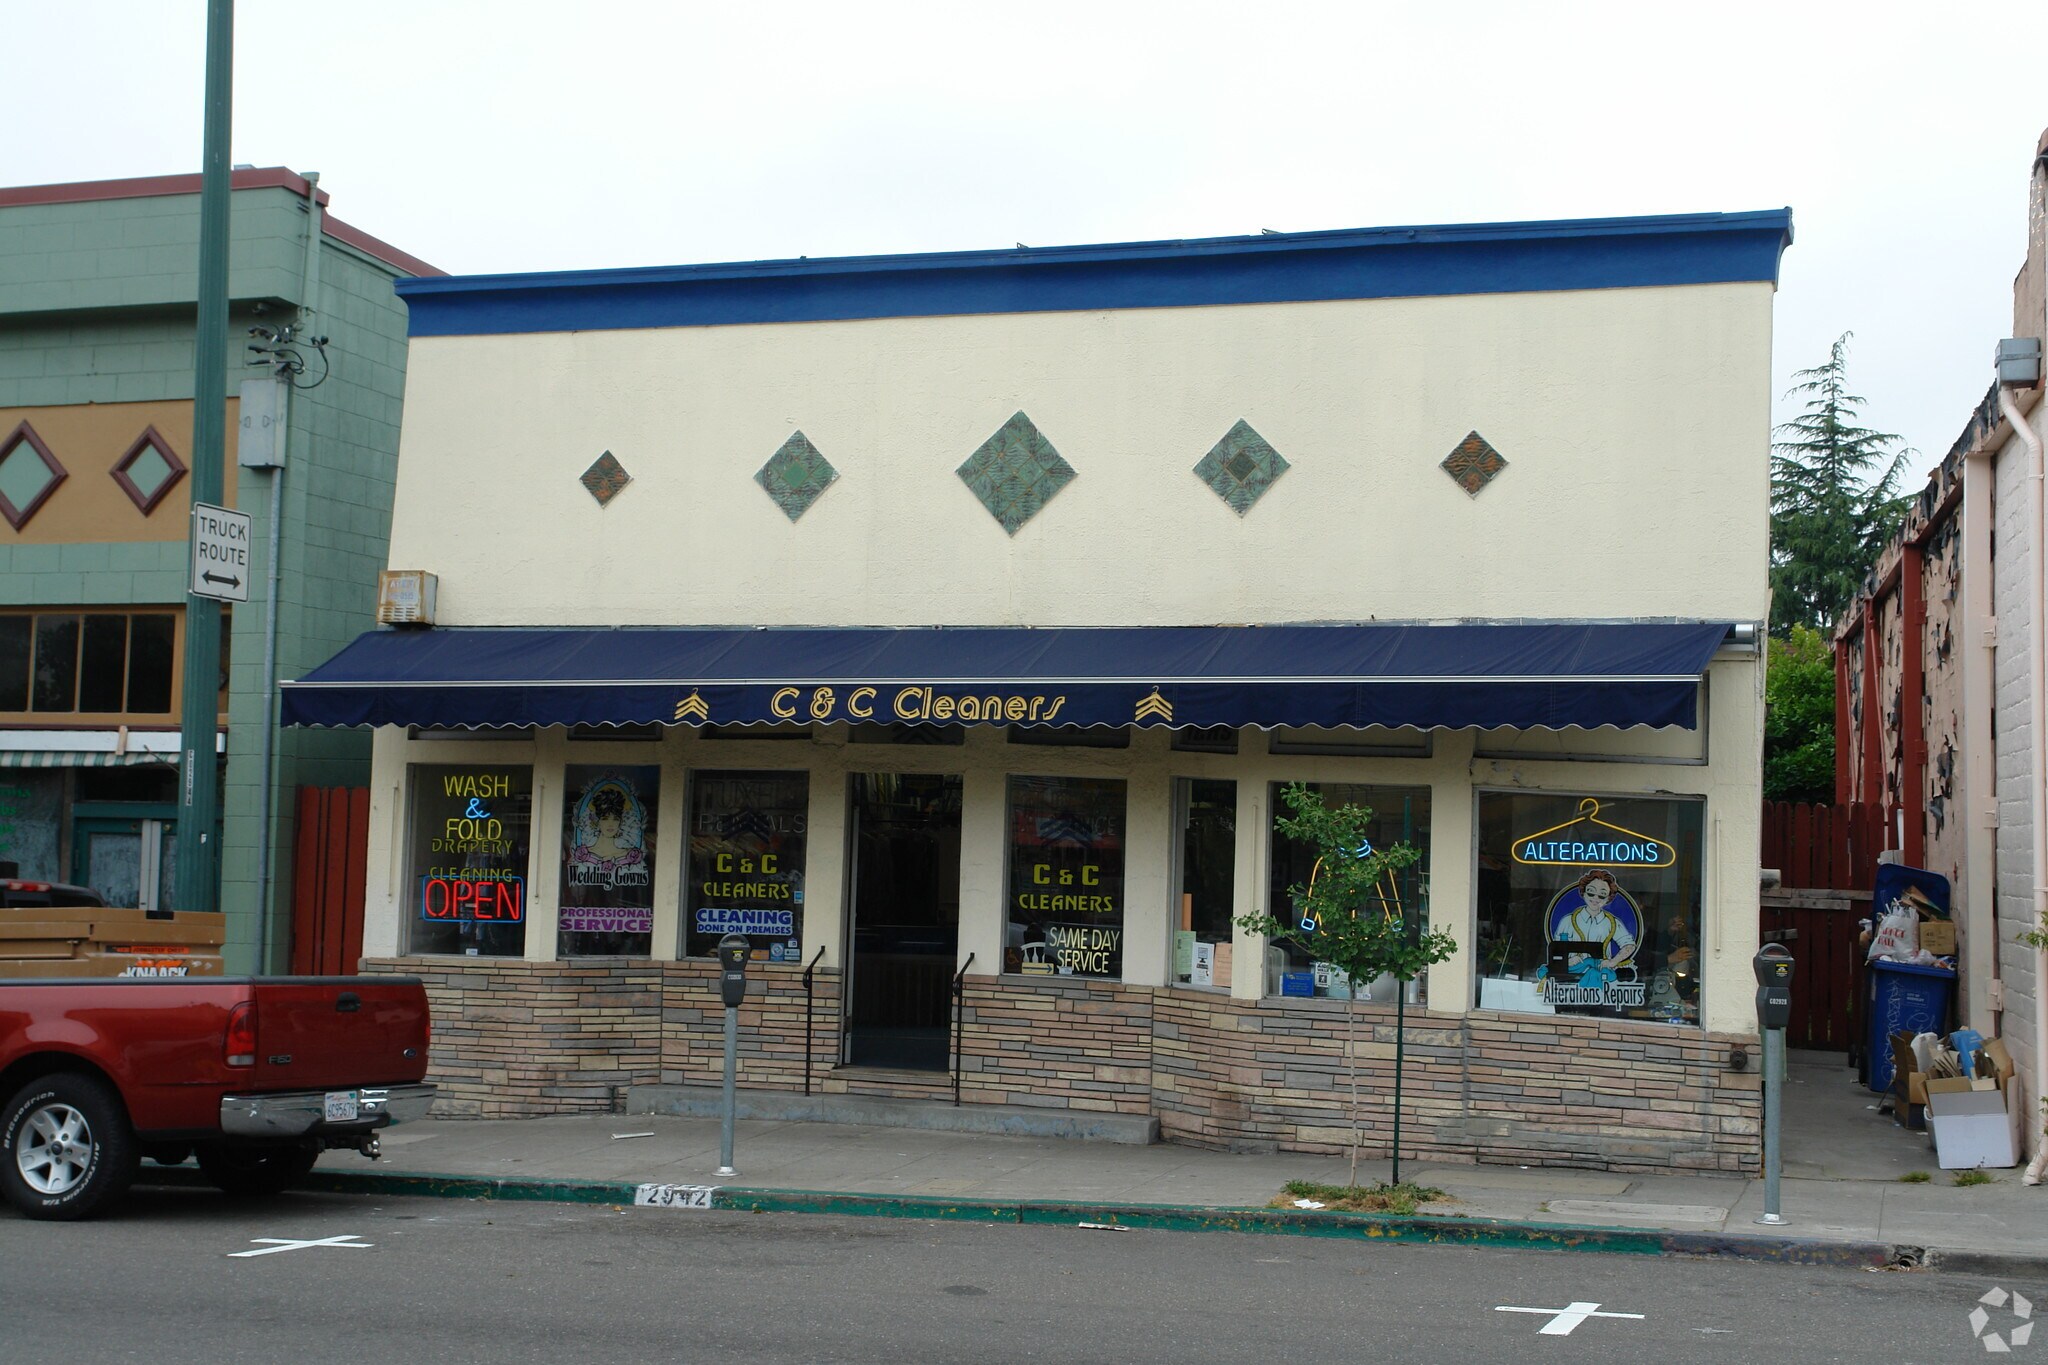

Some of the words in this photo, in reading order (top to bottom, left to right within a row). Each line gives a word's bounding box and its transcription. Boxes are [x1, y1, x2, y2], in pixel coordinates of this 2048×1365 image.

[200, 516, 246, 541] TRUCK
[199, 541, 246, 566] ROUTE
[771, 686, 800, 718] C
[810, 686, 836, 719] &
[847, 686, 877, 718] C
[893, 686, 1066, 721] Cleaners
[444, 774, 509, 797] WASH
[466, 797, 491, 819] &
[446, 818, 502, 840] FOLD
[432, 838, 513, 855] DRAPERY
[1523, 841, 1659, 862] ALTERATIONS
[717, 853, 732, 873] C
[740, 858, 753, 873] &
[761, 854, 777, 874] C
[430, 867, 512, 883] CLEANING
[568, 865, 613, 888] Wedding
[614, 865, 648, 885] Gowns
[1033, 864, 1050, 885] C
[1059, 869, 1074, 886] &
[1081, 865, 1100, 886] C
[425, 879, 520, 920] OPEN
[703, 881, 790, 900] CLEANERS
[560, 908, 652, 918] PROFESSIONAL
[1019, 893, 1113, 912] CLEANERS
[559, 919, 651, 931] SERVICE
[696, 909, 792, 925] CLEANING
[697, 924, 725, 933] DONE
[728, 925, 743, 934] ON
[746, 925, 792, 935] PREMISES
[1049, 926, 1089, 951] SAME
[1091, 929, 1121, 951] DAY
[126, 966, 188, 977] KNAACK
[1057, 949, 1110, 974] SERVICE
[1543, 978, 1601, 1004] Alterations
[1602, 981, 1646, 1011] Repairs
[3, 1091, 55, 1149] BFGoodrich
